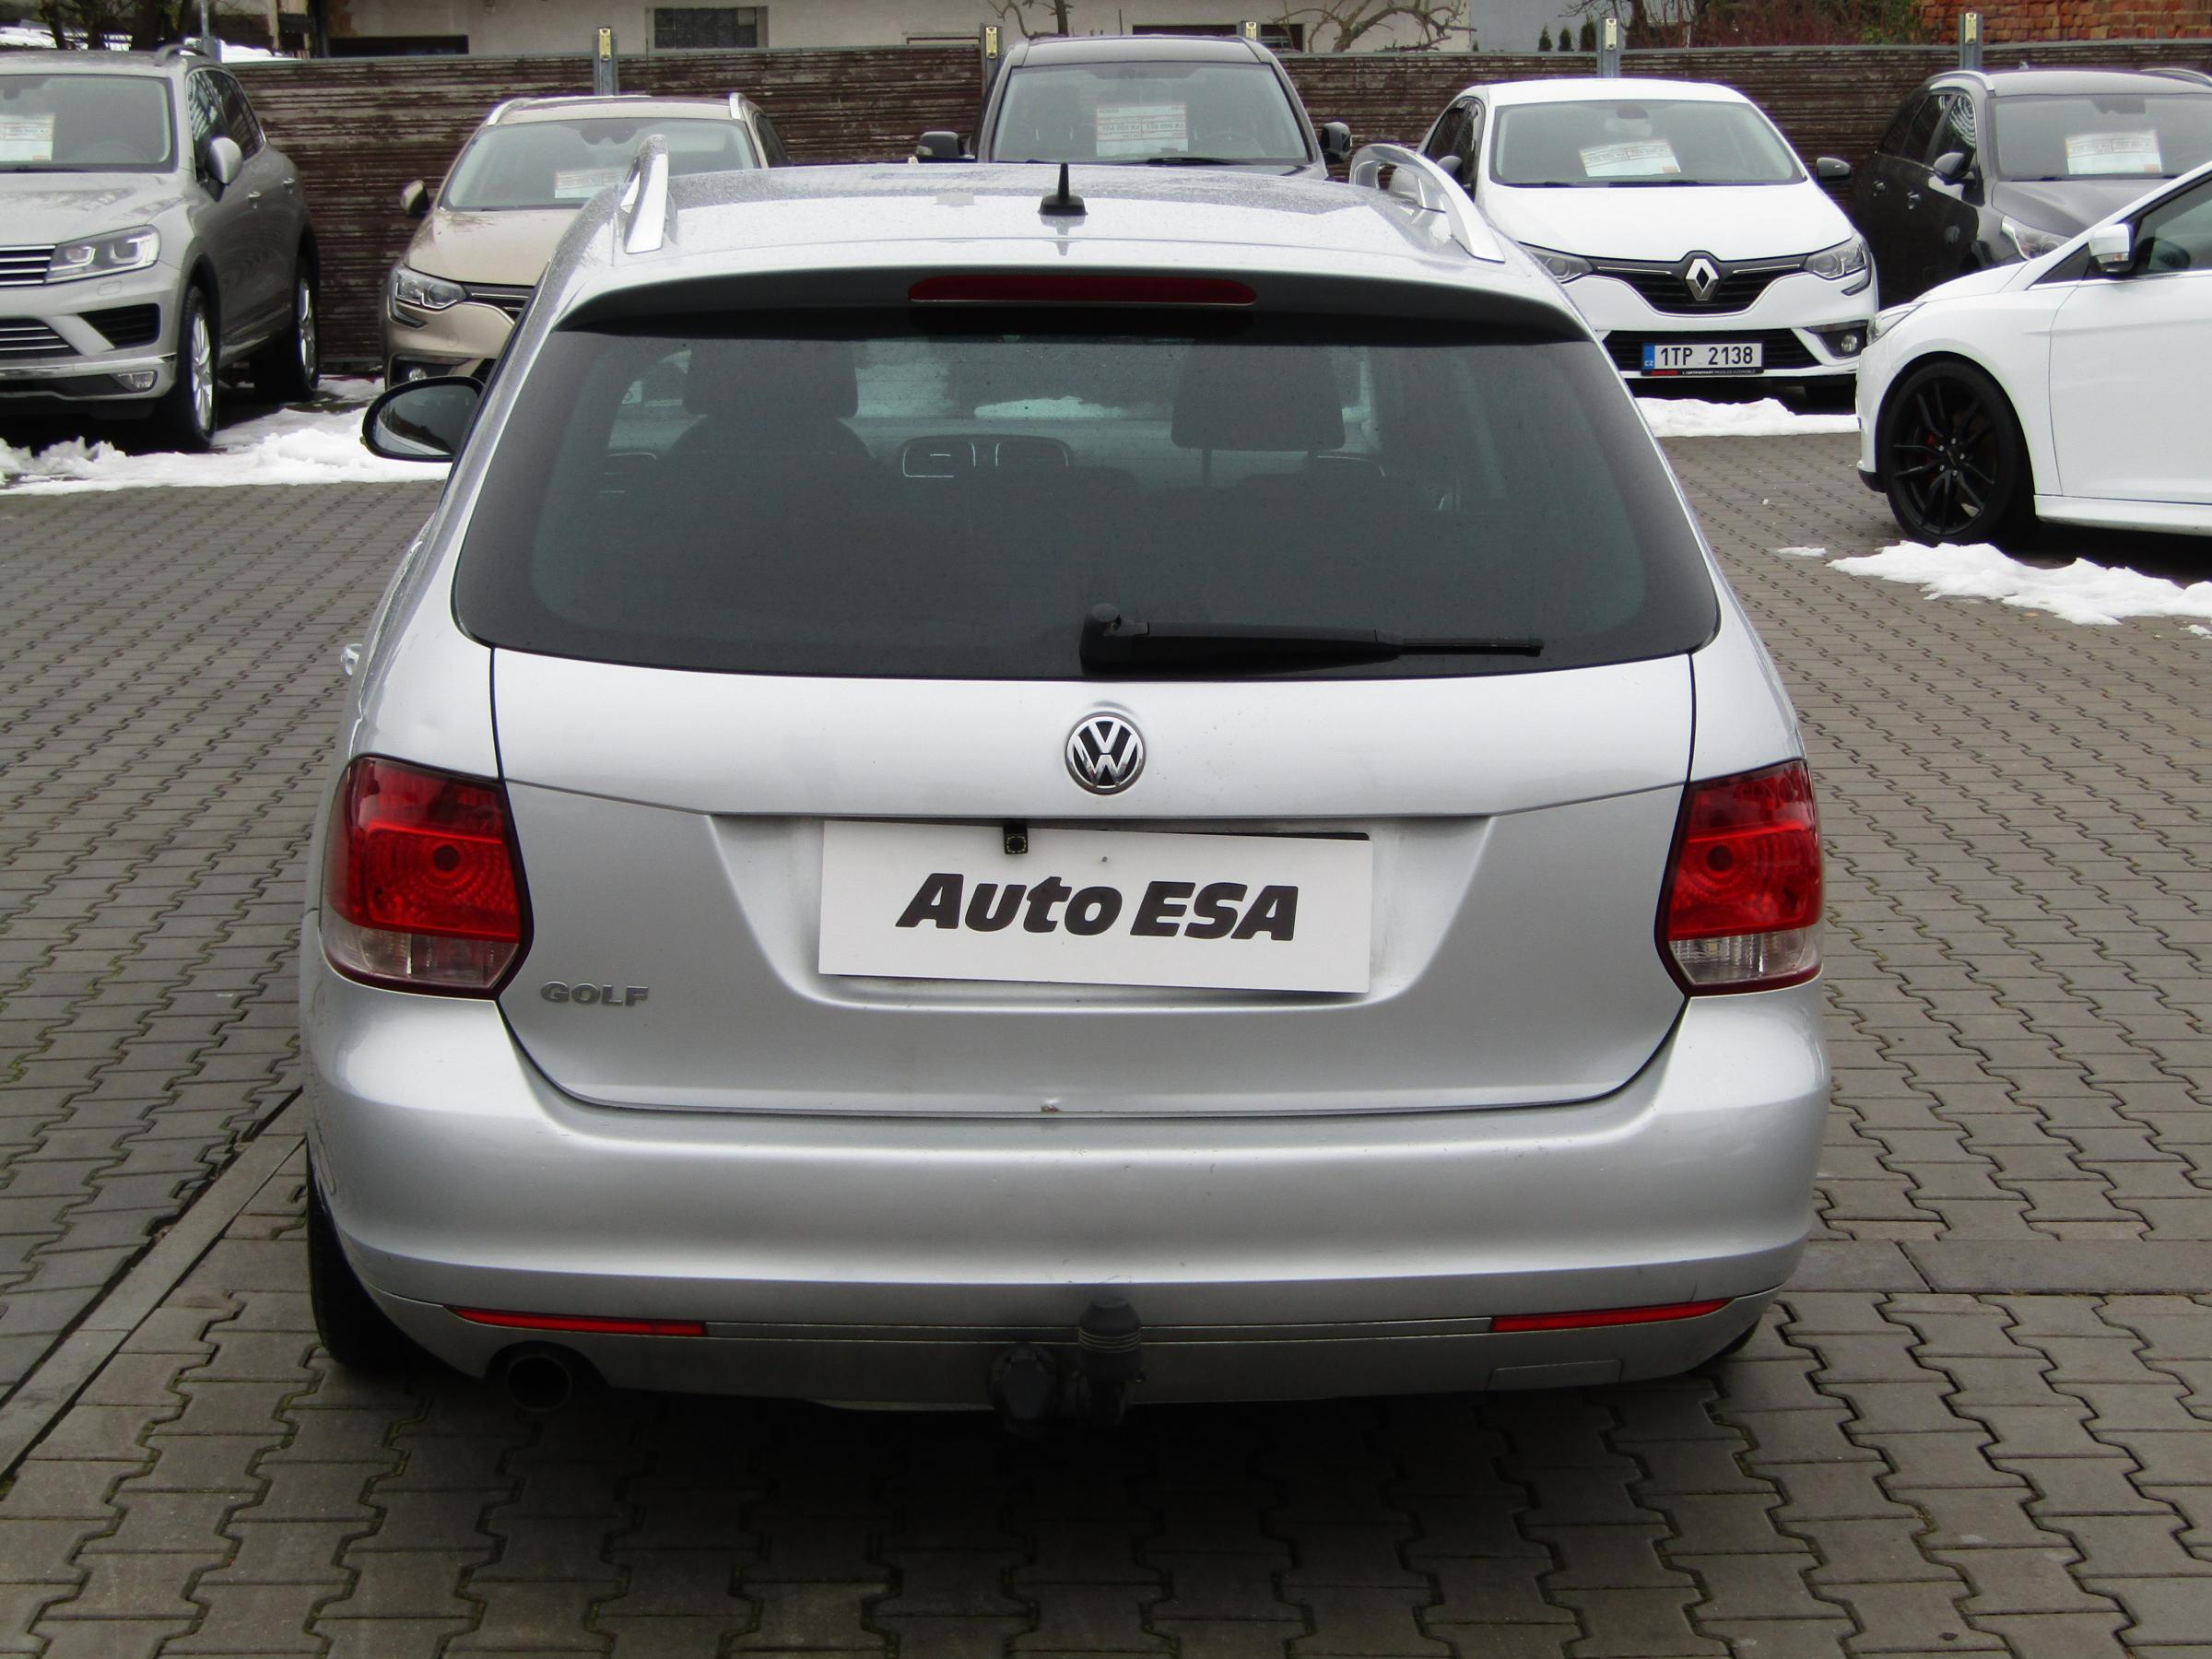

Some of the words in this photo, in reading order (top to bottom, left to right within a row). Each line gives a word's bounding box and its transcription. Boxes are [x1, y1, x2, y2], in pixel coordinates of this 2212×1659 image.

[1660, 347, 1693, 366] 1TP
[1708, 347, 1753, 365] 2138
[895, 873, 1123, 935] Auto
[1130, 881, 1299, 941] ESA
[540, 981, 649, 1006] GOLF
